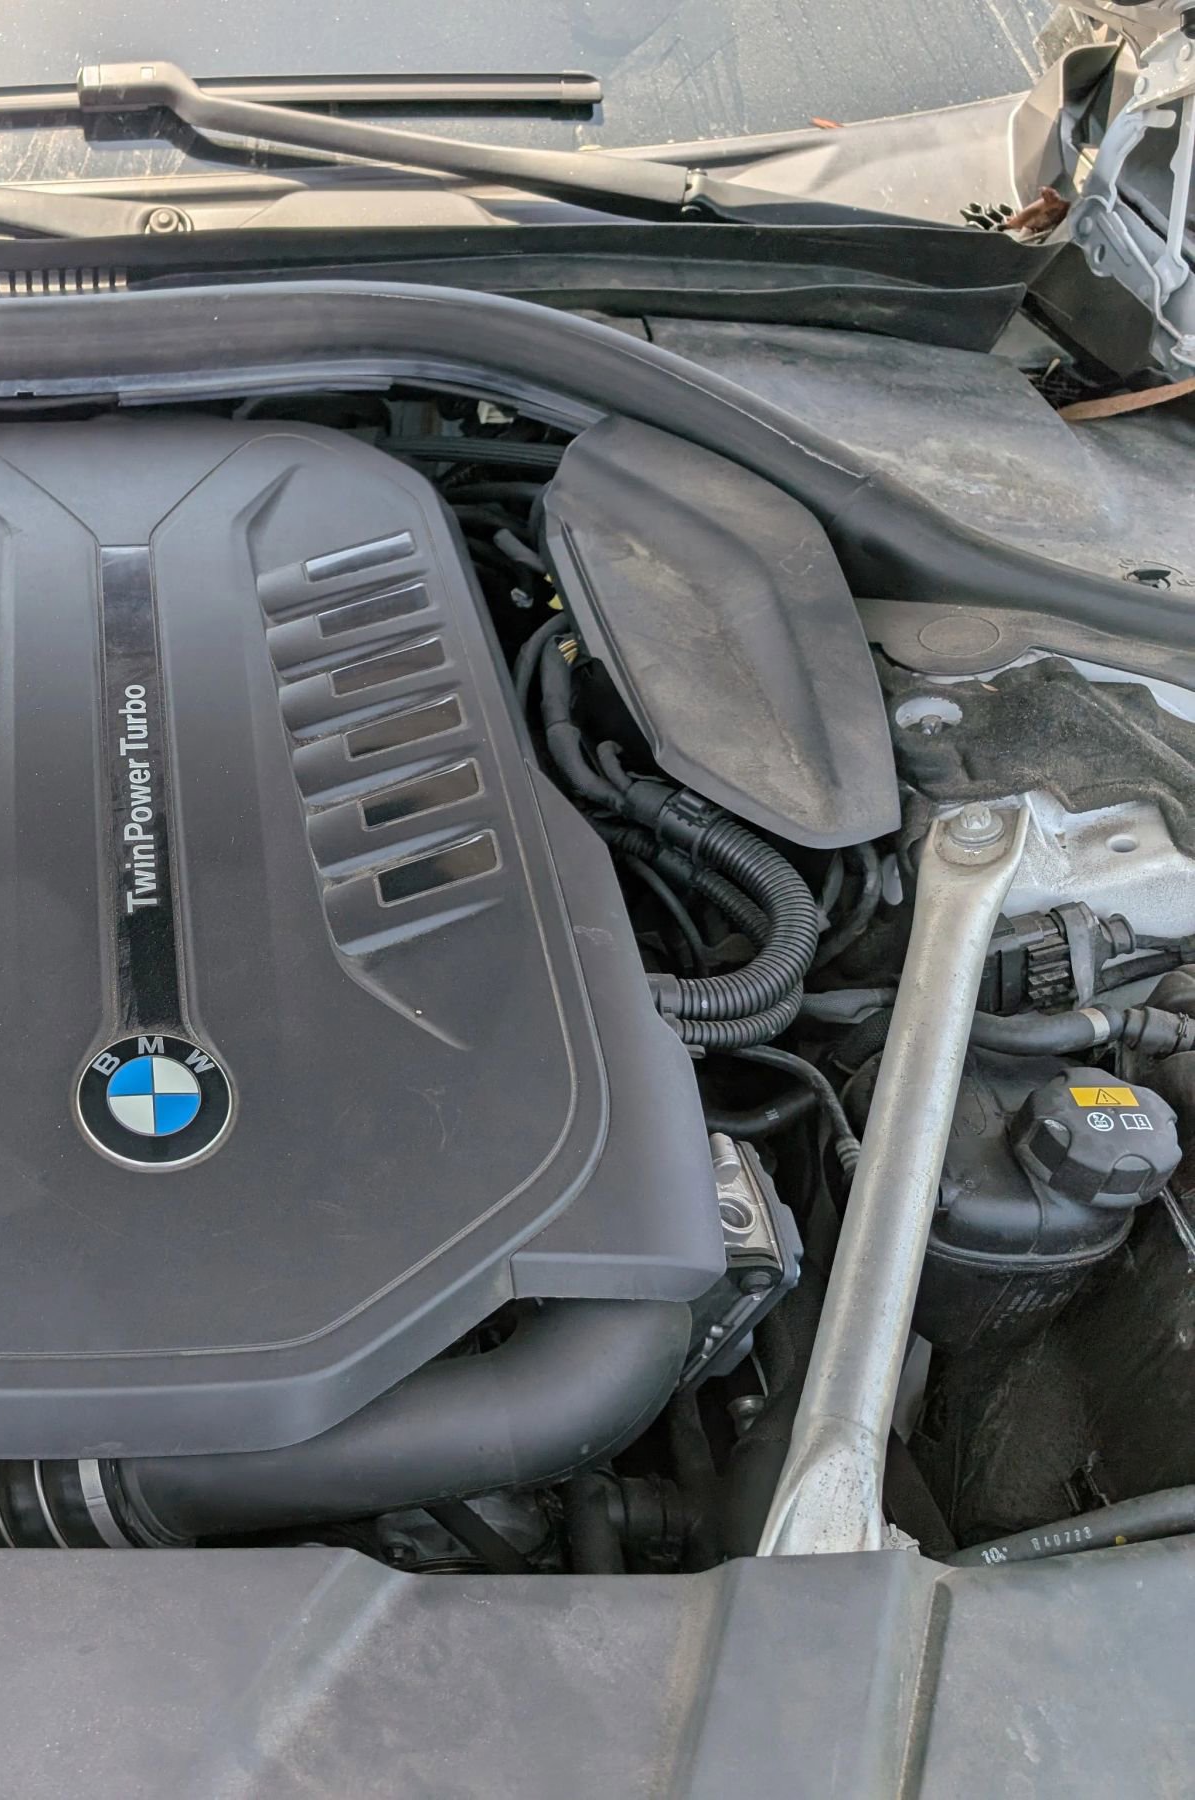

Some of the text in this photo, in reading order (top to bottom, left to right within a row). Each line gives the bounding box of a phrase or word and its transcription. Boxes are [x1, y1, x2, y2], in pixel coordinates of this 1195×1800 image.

[118, 684, 158, 913] TwinPower Turbo
[92, 1036, 215, 1077] BMW
